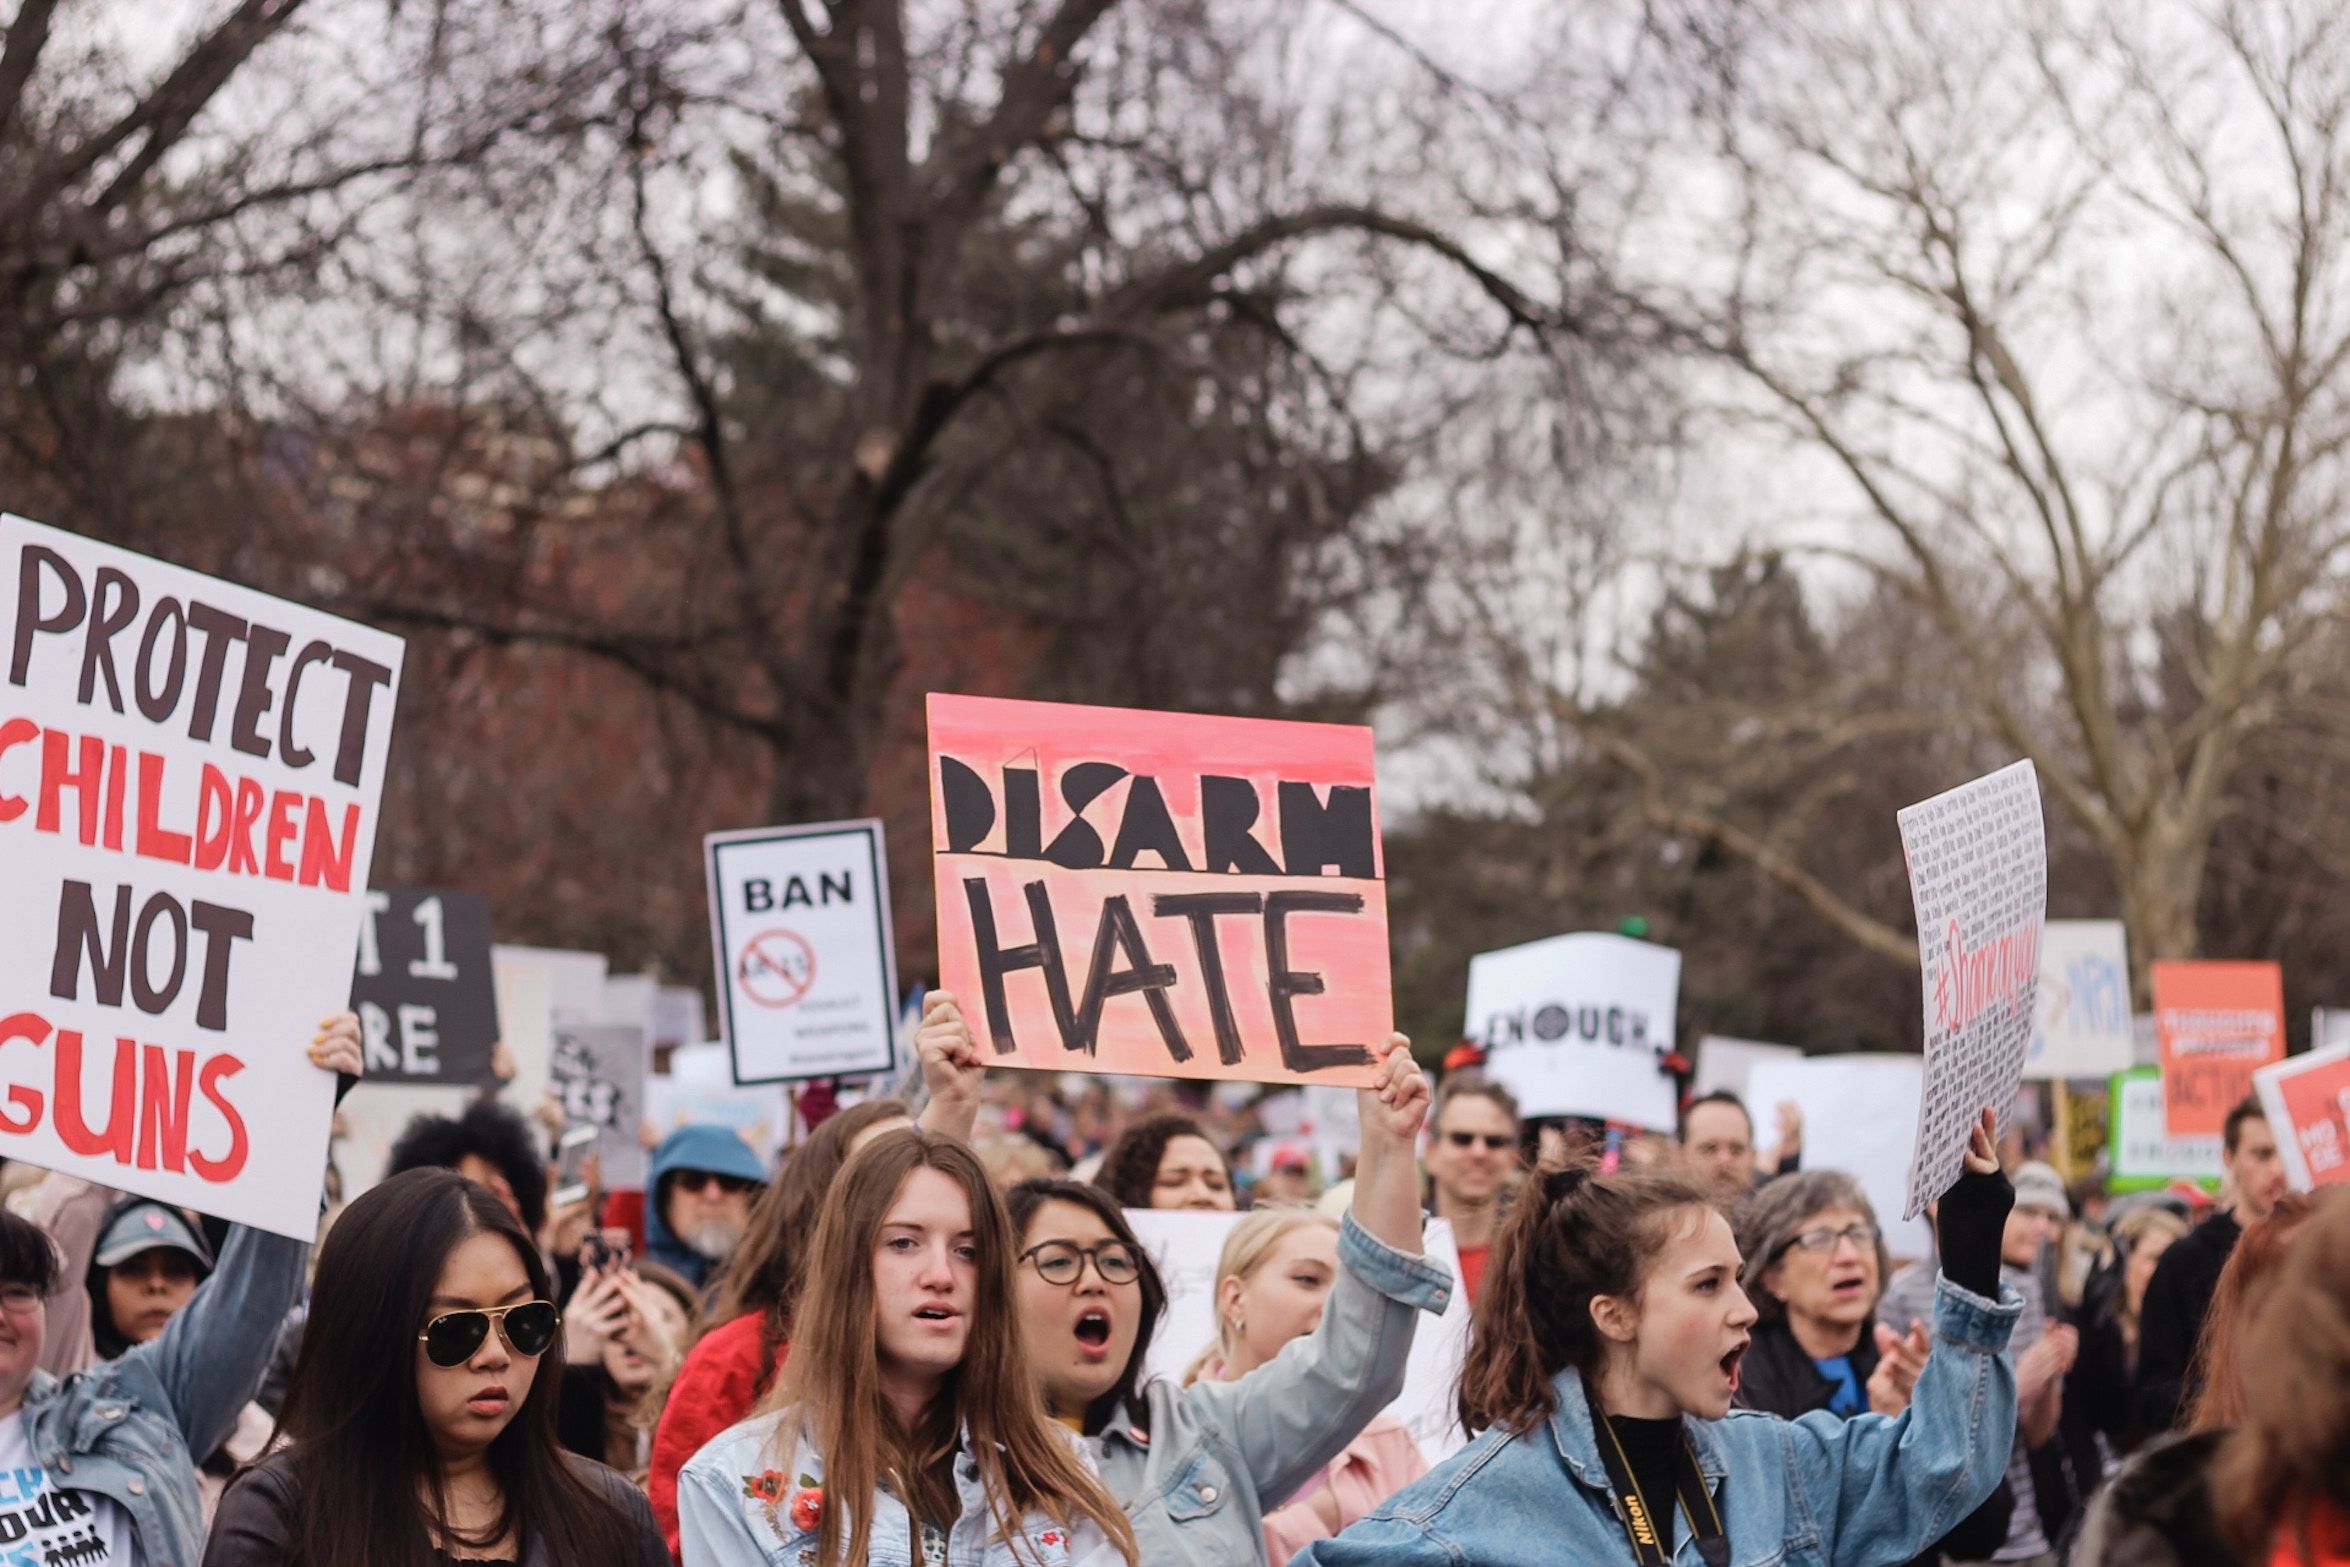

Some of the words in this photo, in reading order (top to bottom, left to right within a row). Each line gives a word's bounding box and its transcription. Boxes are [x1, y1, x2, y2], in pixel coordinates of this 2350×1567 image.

[9, 544, 392, 789] PROTECT
[0, 717, 360, 893] CHILDREN
[939, 754, 1376, 879] DISARM
[50, 879, 254, 1031] NOT
[408, 896, 458, 980] 1
[743, 871, 853, 913] BAN
[963, 877, 1377, 1072] HATE
[0, 1012, 249, 1183] GUNS
[1624, 1495, 1655, 1545] Nikon
